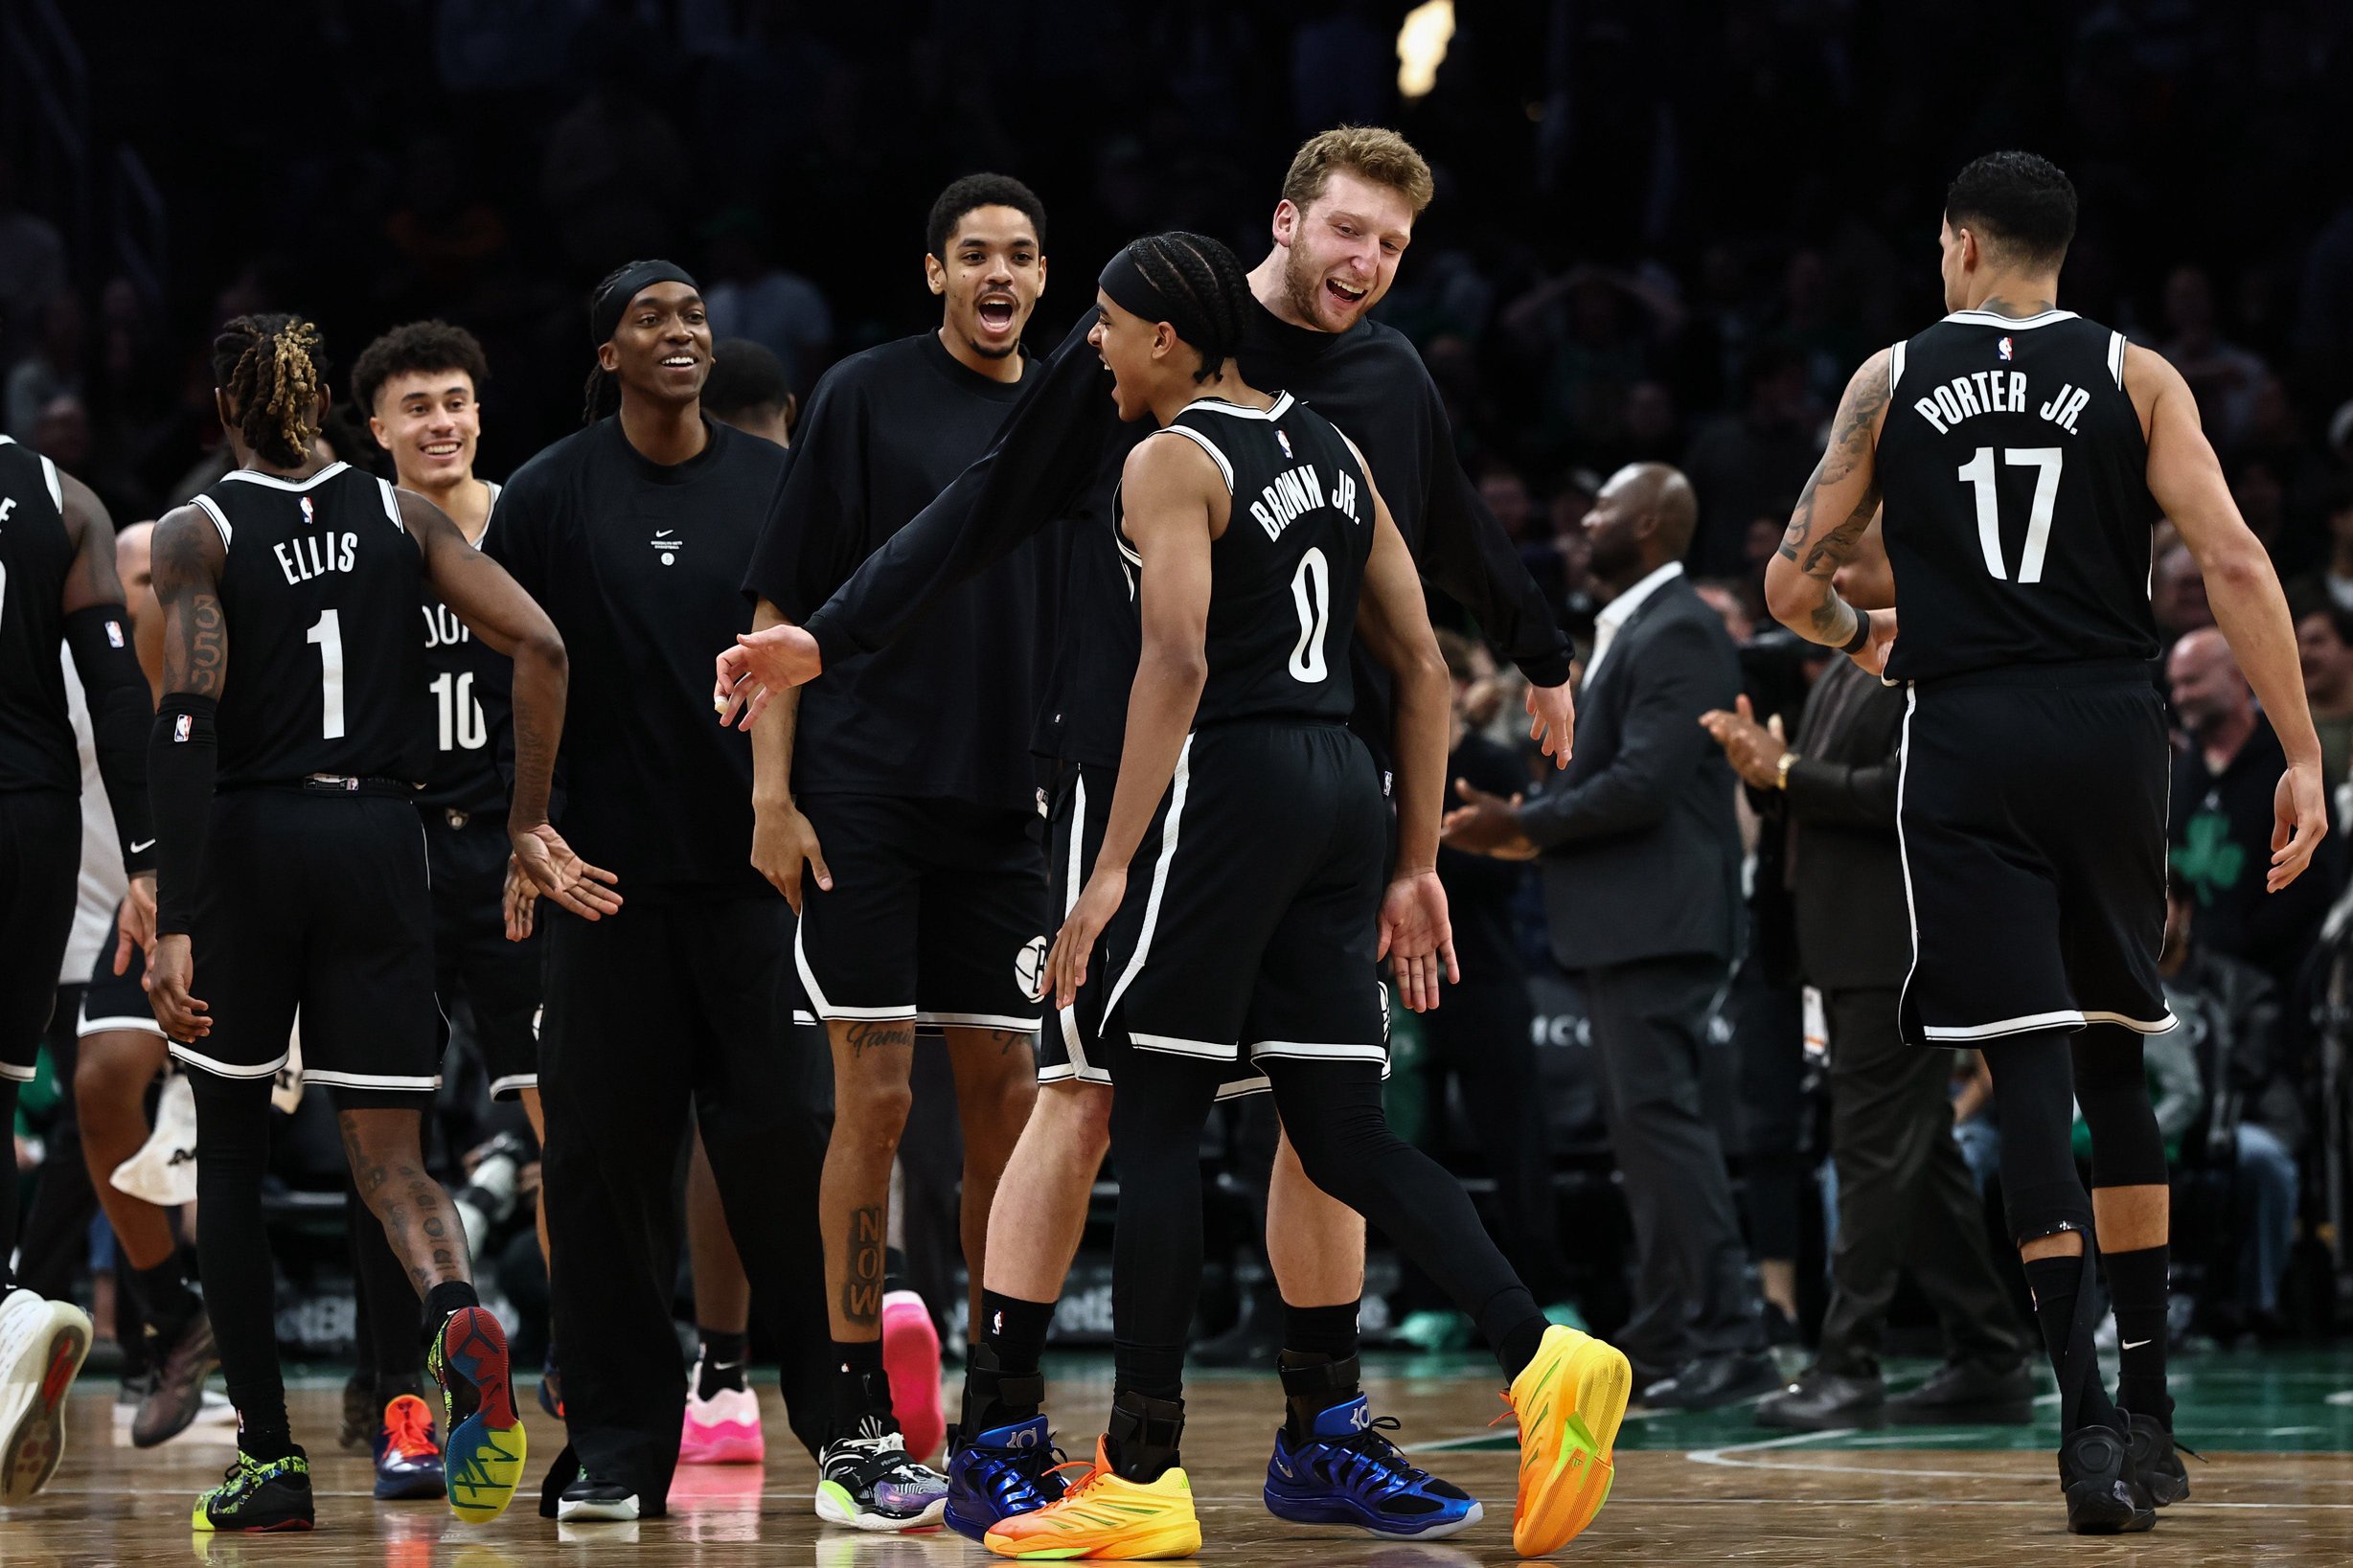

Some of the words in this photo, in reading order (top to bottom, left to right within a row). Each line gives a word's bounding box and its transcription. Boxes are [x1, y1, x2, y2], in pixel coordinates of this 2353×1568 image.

[1913, 370, 2027, 436] PORTER
[2039, 383, 2090, 436] JR.
[1248, 464, 1326, 543] BROWN
[1331, 468, 1360, 526] JR.
[1957, 446, 2064, 584] 17
[272, 531, 358, 586] ELLIS
[1289, 546, 1329, 684] 0
[306, 608, 346, 740] 1
[429, 671, 488, 752] 10
[849, 1208, 880, 1316] NOW
